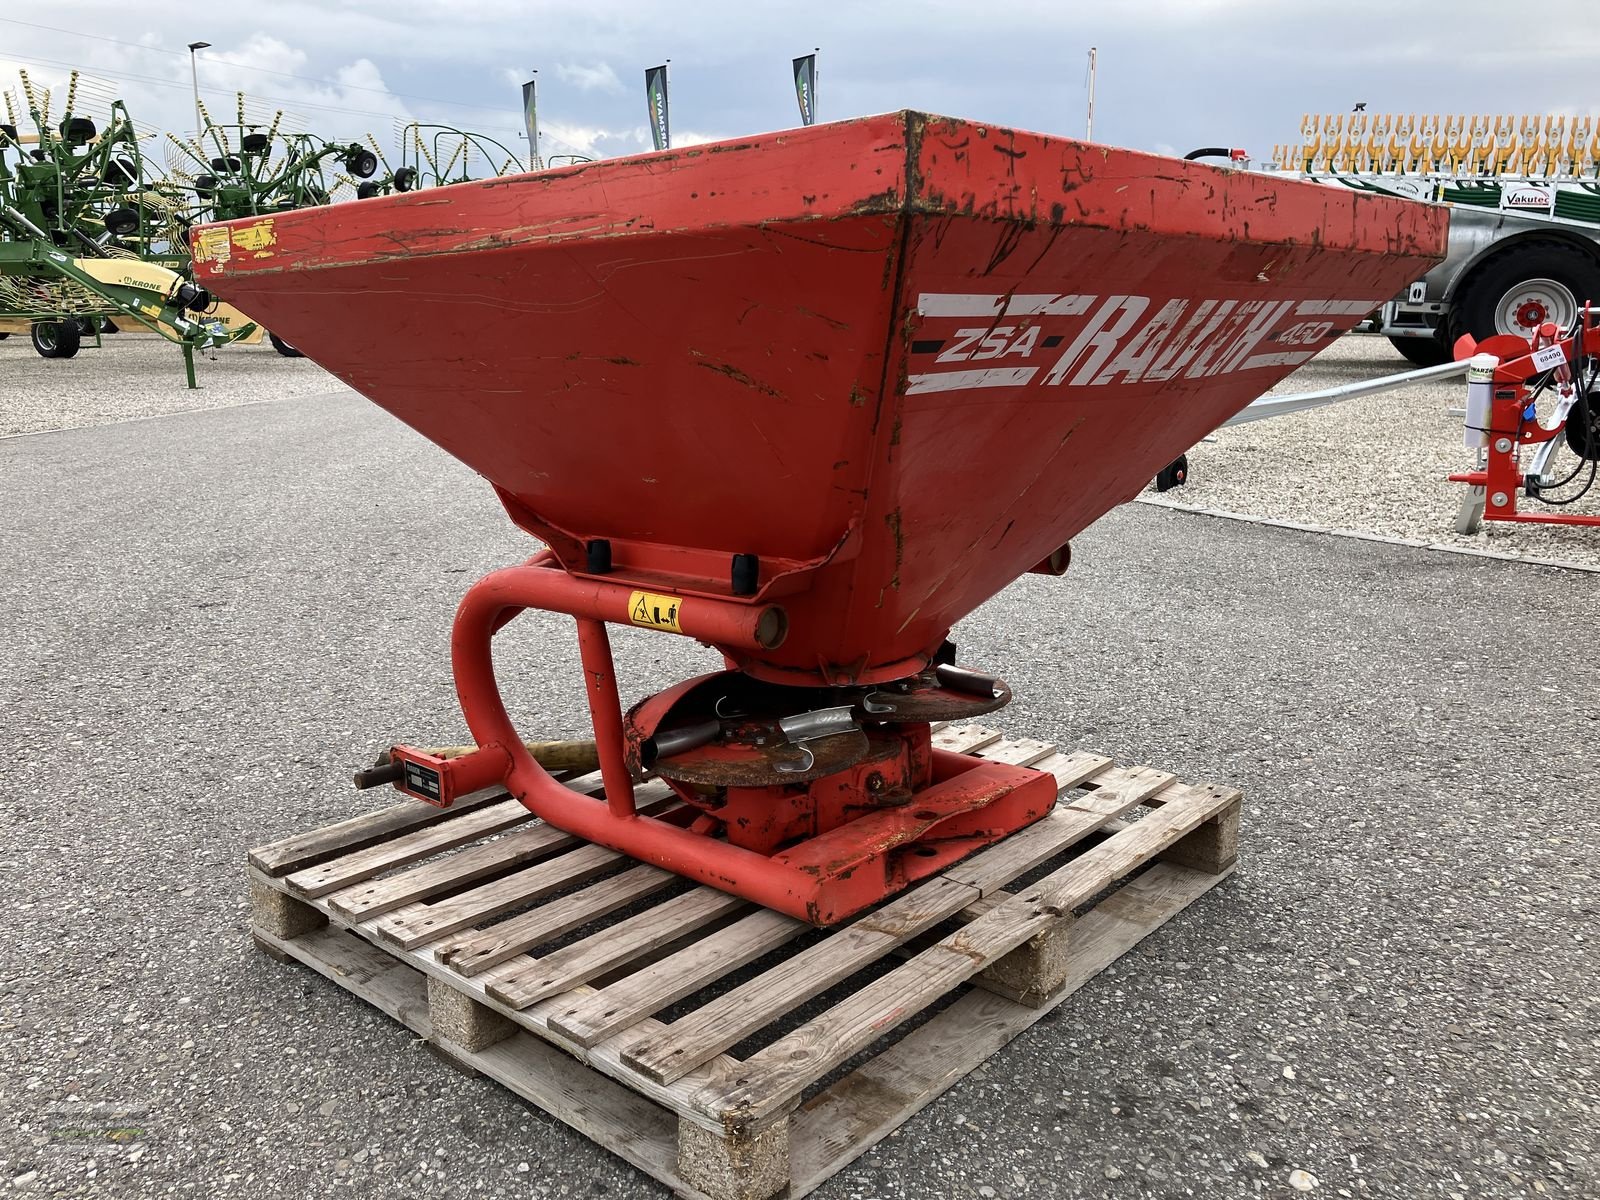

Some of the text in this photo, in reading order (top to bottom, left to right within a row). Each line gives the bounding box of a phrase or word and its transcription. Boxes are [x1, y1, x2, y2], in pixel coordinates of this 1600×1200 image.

[1506, 193, 1550, 205] Vakutec
[132, 279, 162, 291] KRONE
[934, 326, 1041, 363] ZSA
[1040, 295, 1296, 386] RAUCH
[1539, 351, 1561, 363] 68490
